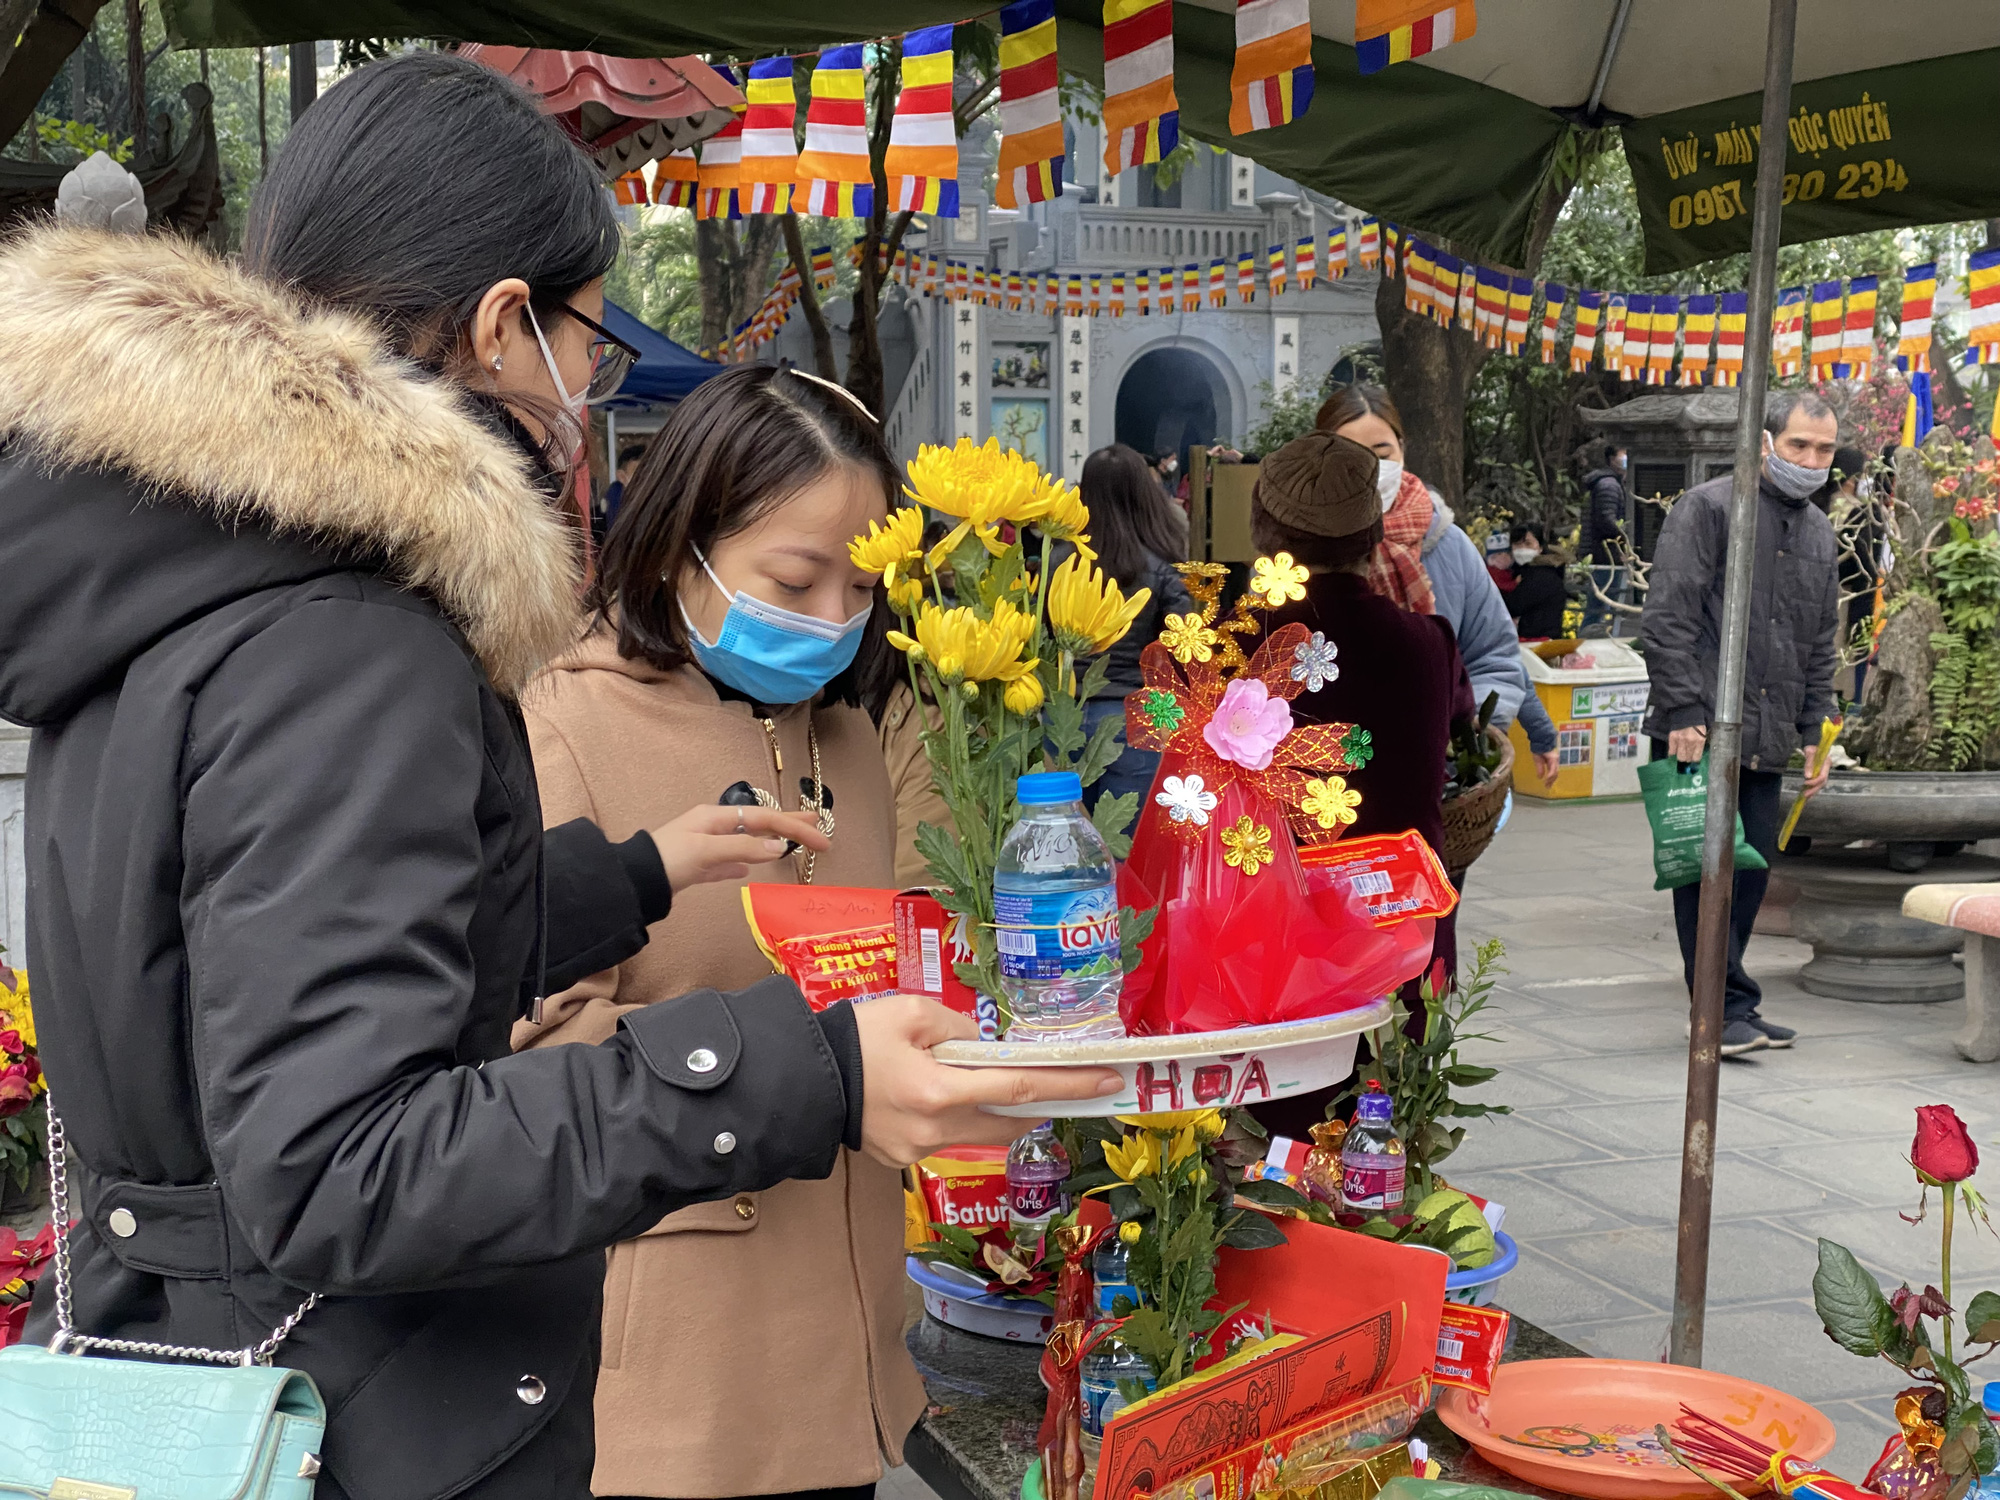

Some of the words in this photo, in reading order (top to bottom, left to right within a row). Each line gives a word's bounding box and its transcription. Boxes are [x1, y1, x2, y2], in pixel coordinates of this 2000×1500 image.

[1714, 120, 1753, 166] MÁI
[1787, 105, 1829, 159] ĐỘC
[1828, 91, 1891, 151] QUYỀN
[1669, 180, 1747, 229] 0967
[1835, 158, 1909, 201] 234
[813, 942, 851, 954] Hương
[1344, 1179, 1365, 1194] Oris
[1016, 1196, 1043, 1210] Oris
[944, 1201, 1009, 1226] Satur
